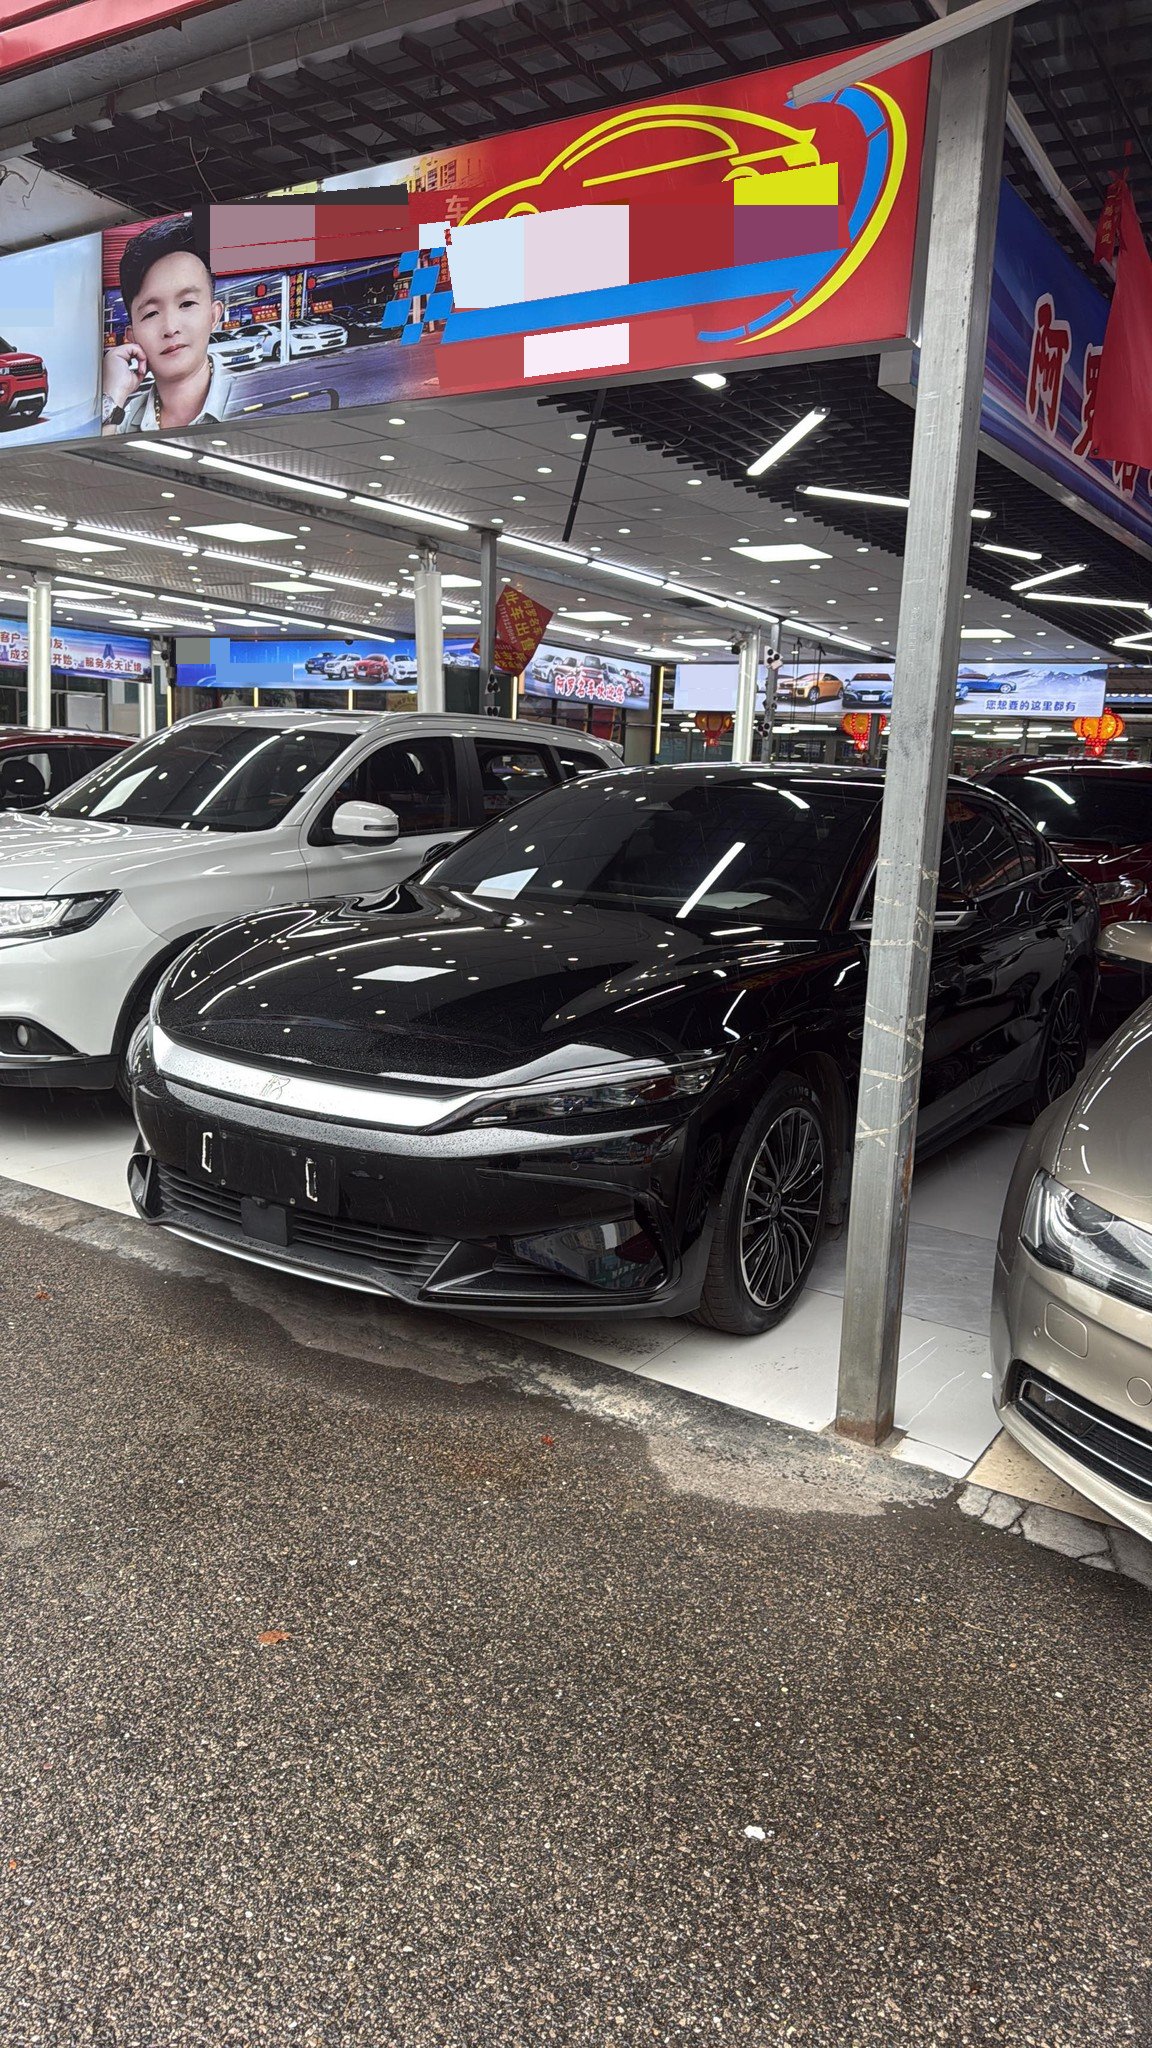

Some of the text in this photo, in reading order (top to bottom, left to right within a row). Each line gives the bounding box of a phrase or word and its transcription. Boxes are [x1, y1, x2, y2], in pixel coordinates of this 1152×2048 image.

[503, 591, 535, 650] 此车出售
[985, 699, 1077, 712] 您想要的这里都有
